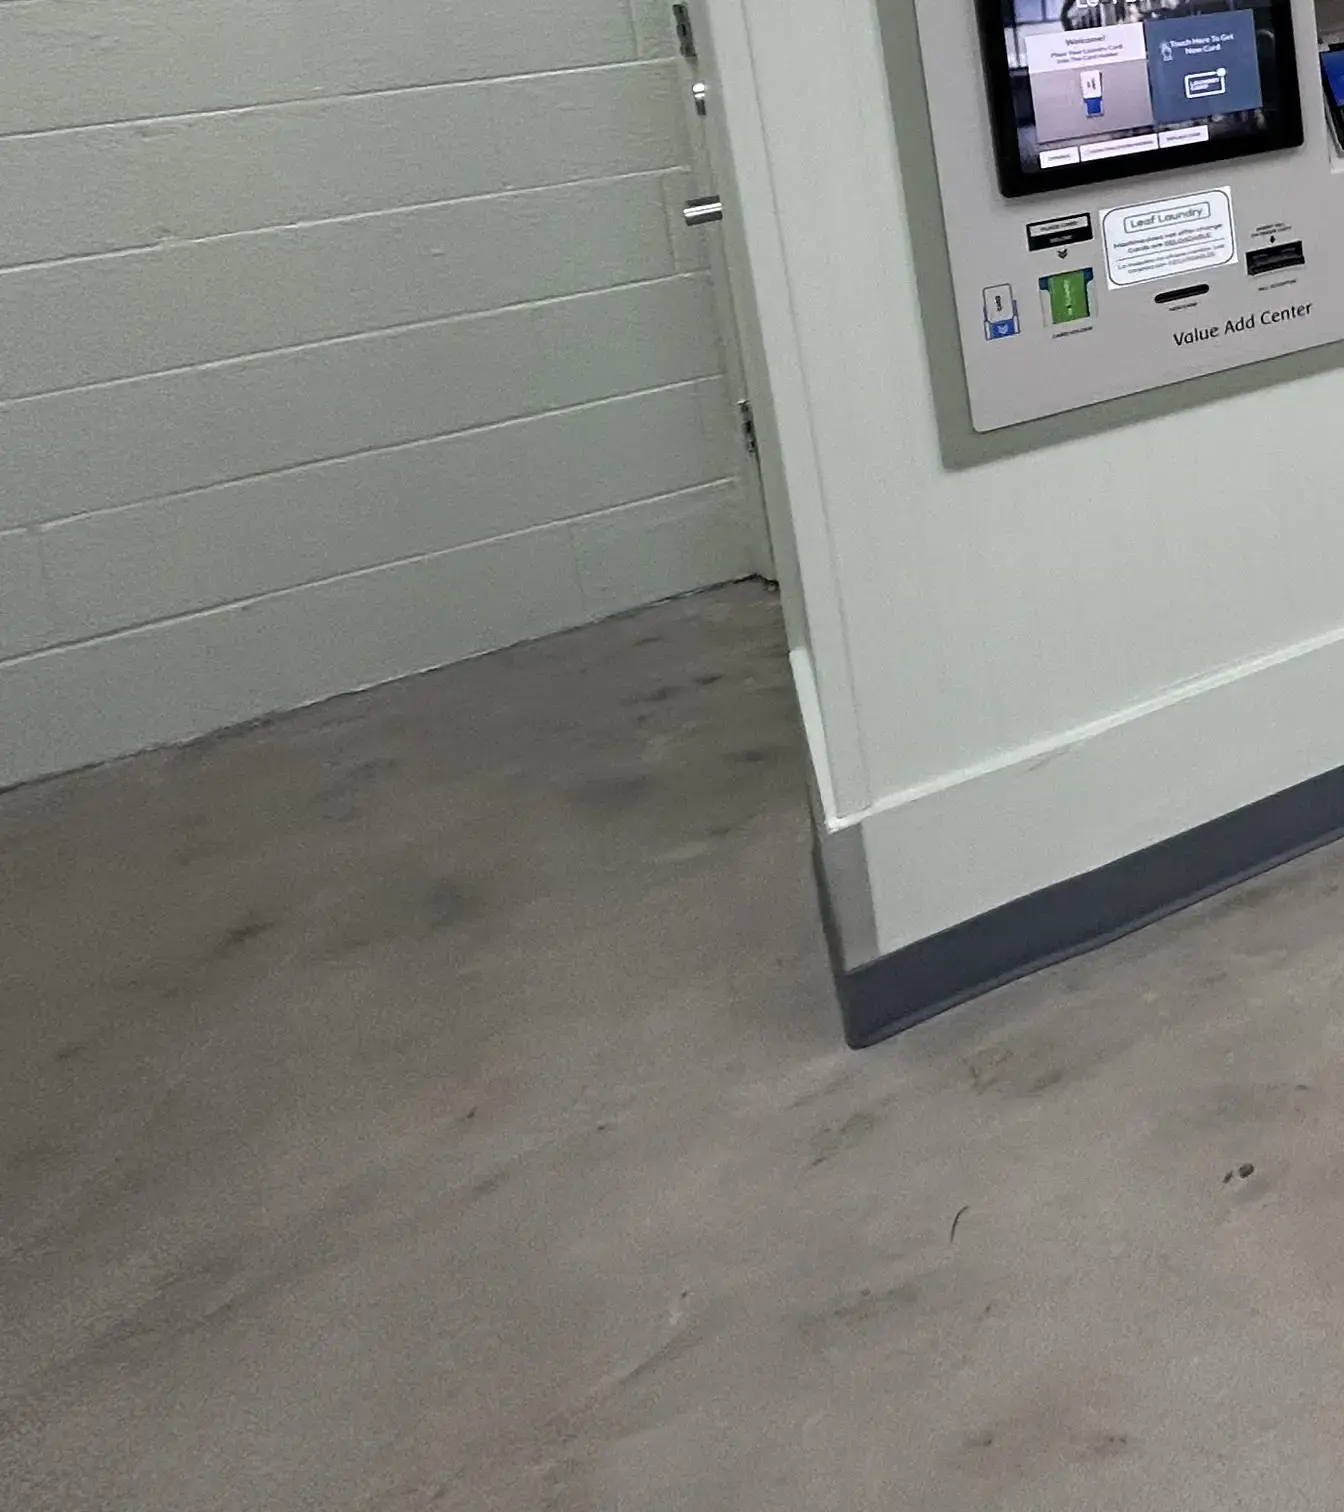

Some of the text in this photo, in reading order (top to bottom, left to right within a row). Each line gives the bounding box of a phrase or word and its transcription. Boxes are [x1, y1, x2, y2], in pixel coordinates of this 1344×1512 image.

[1129, 207, 1204, 229] Leaf Laundry
[1172, 302, 1313, 347] Value Add Center
